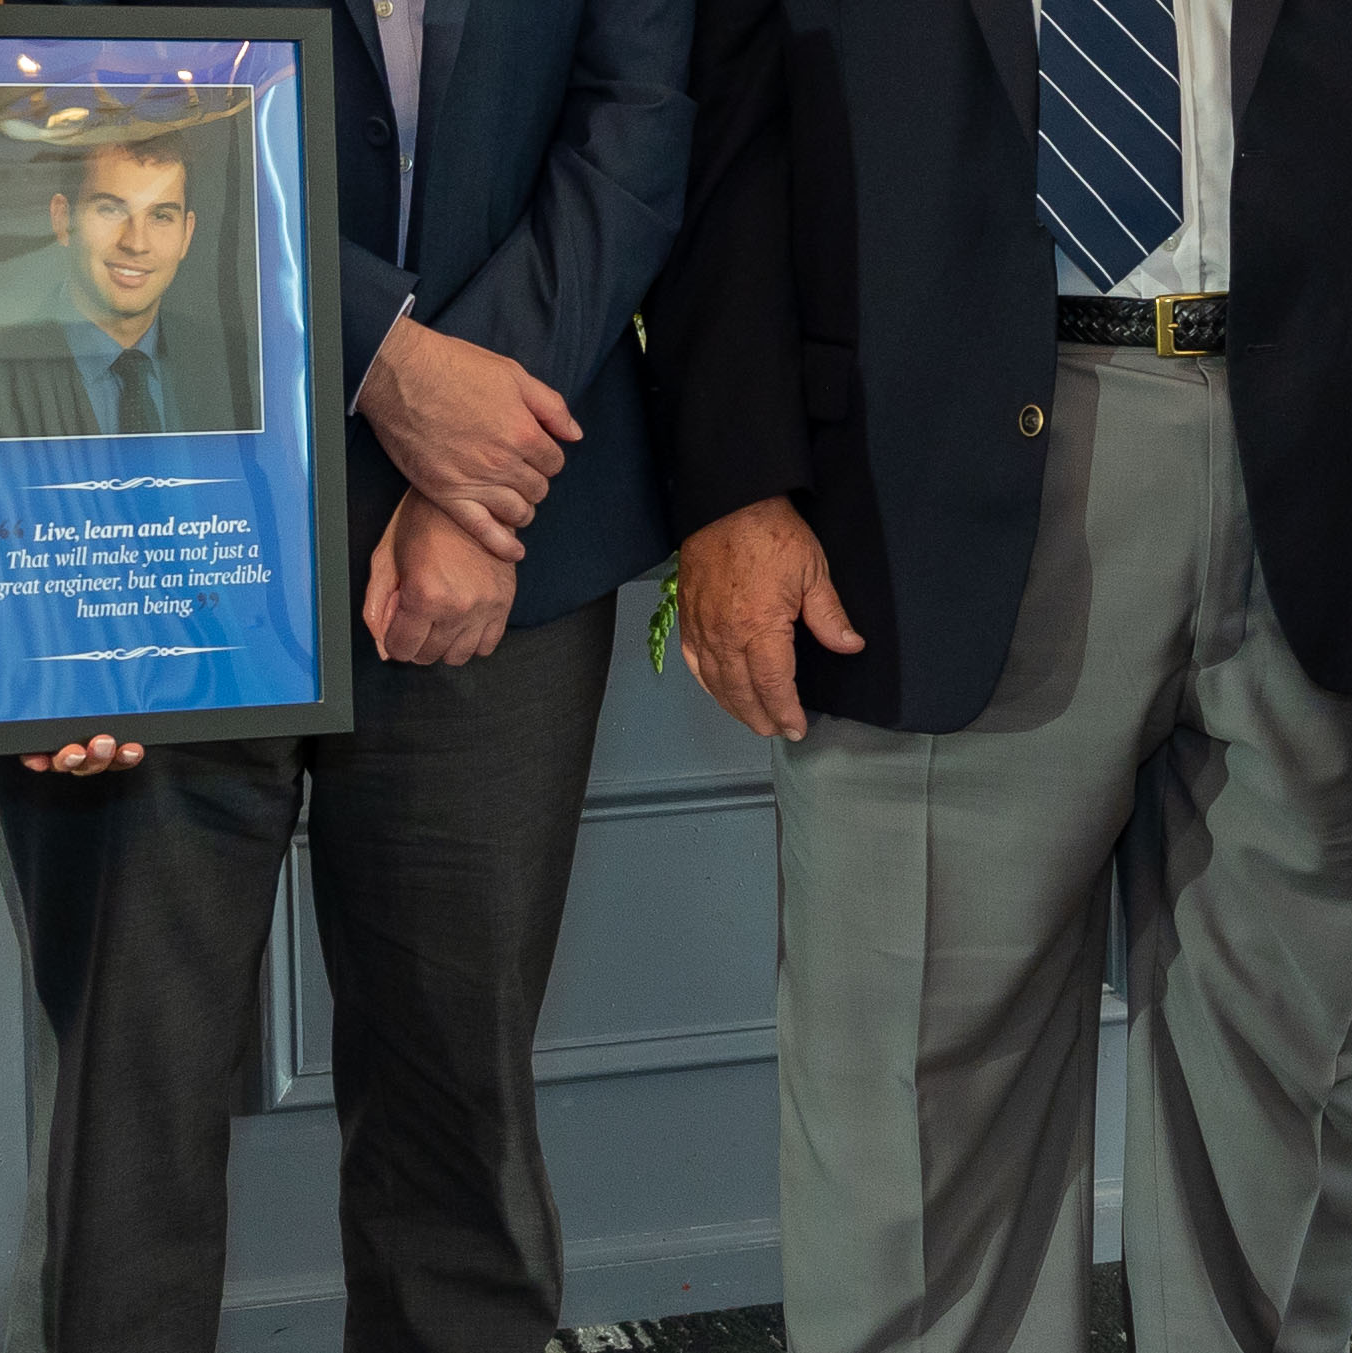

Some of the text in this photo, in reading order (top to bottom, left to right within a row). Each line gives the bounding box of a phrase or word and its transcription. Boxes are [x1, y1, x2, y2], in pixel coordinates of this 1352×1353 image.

[33, 514, 251, 542] Live, learn and explore.
[7, 542, 259, 569] That will make you not just a
[44, 574, 123, 597] engineer,
[128, 570, 157, 590] but
[161, 574, 183, 588] an
[188, 564, 272, 586] incredible
[77, 595, 193, 618] human being.
